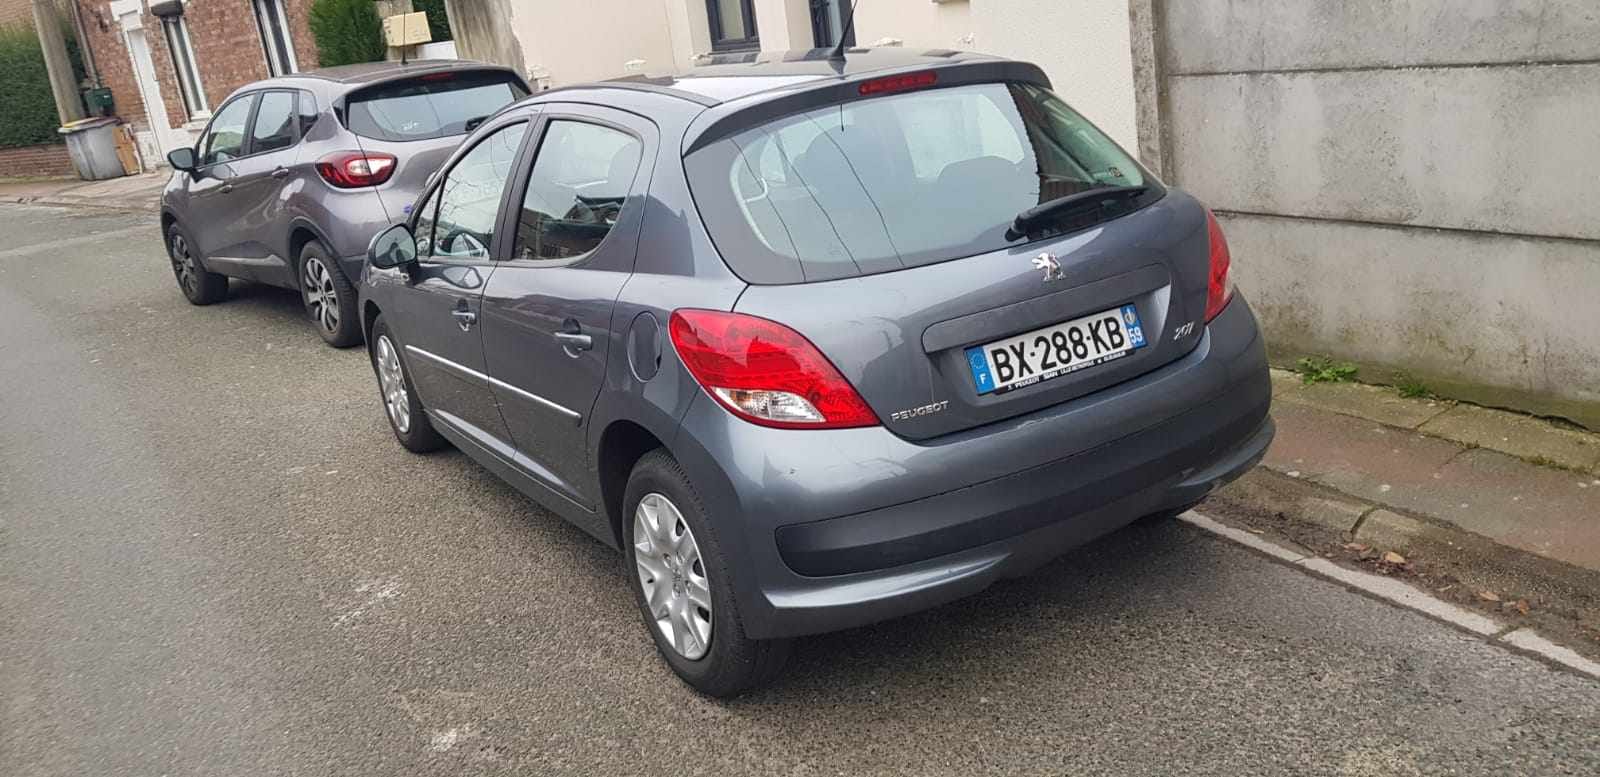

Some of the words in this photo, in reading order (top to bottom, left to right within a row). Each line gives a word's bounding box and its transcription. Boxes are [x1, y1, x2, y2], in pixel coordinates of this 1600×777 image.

[1128, 326, 1143, 344] 59
[1173, 321, 1195, 340] 207
[991, 316, 1125, 383] BX-288-KB
[980, 373, 987, 385] F
[891, 400, 949, 422] PEUGEOT
